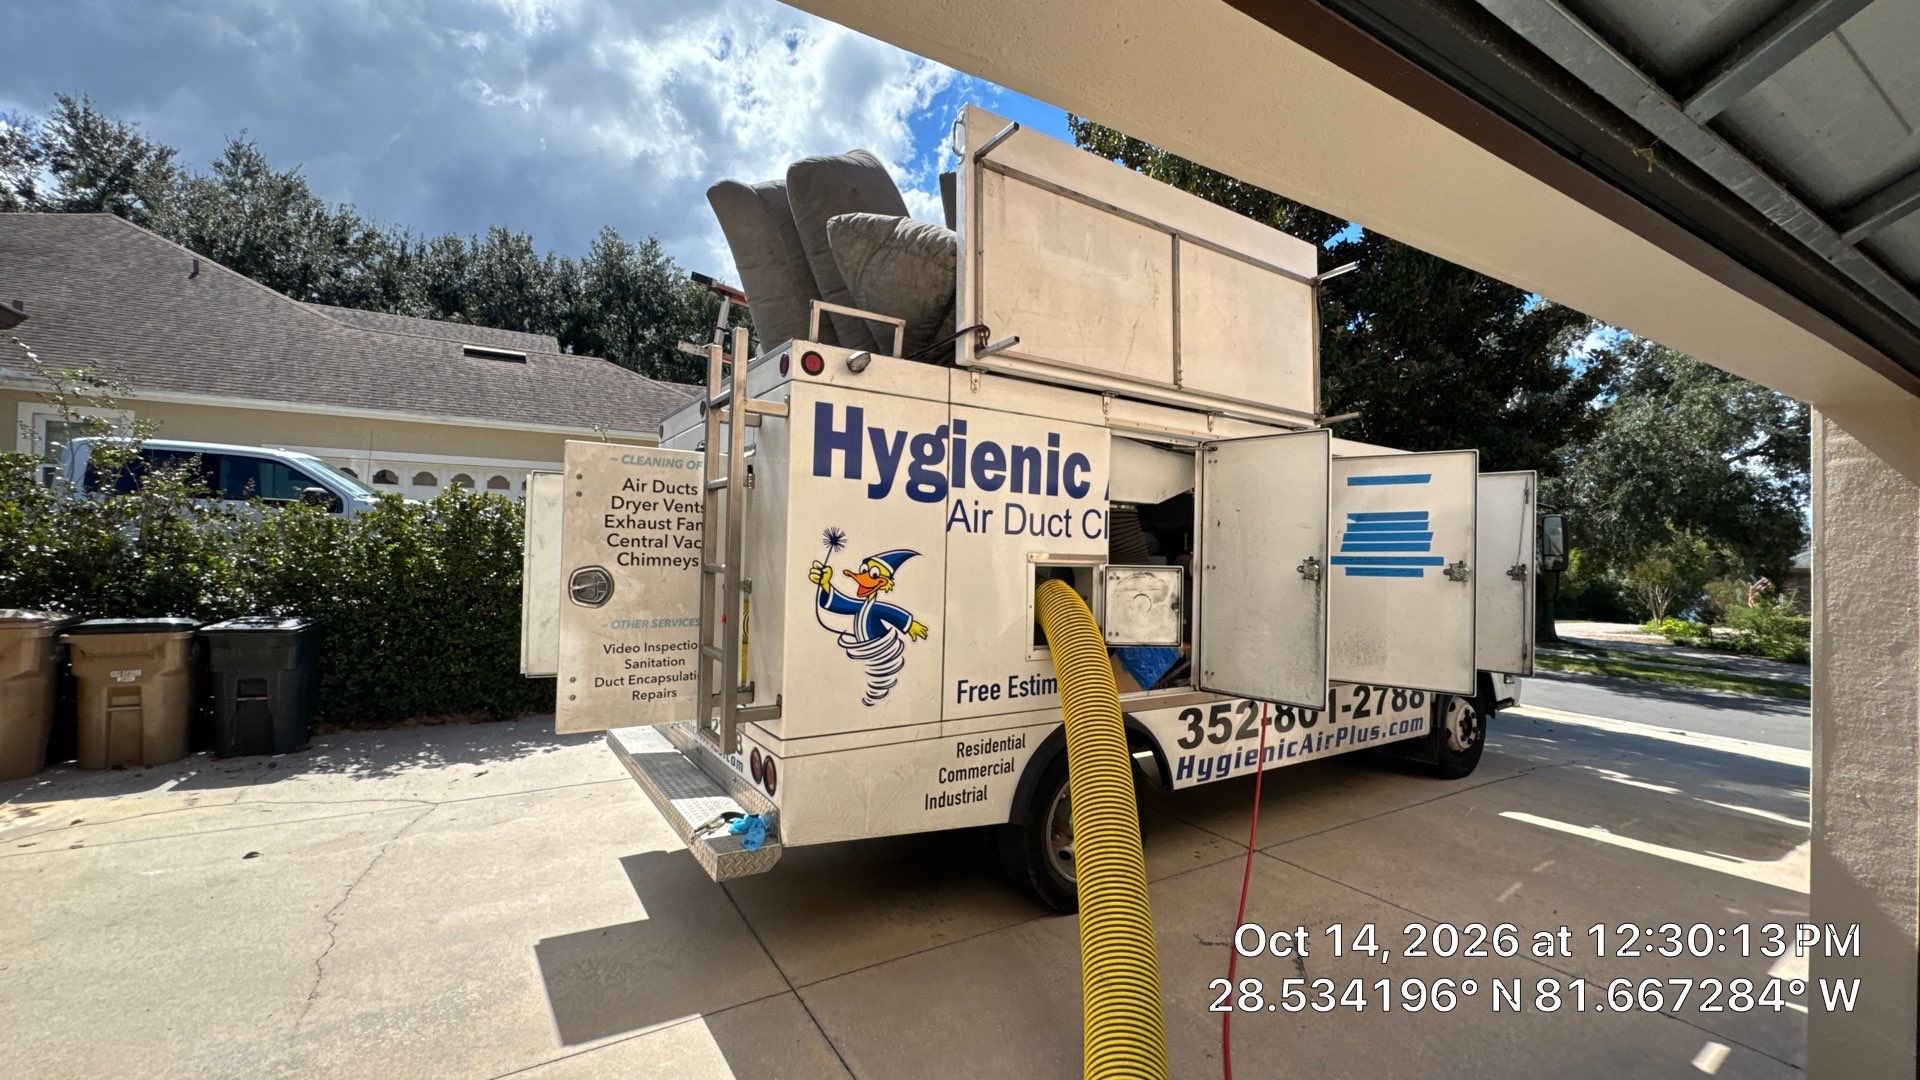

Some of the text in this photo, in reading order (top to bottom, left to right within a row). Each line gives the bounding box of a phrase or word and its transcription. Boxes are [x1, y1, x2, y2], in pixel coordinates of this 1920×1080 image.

[812, 400, 1092, 504] Hygienic
[621, 454, 684, 470] CLEANING
[686, 460, 703, 471] OF
[622, 477, 699, 496] Air Ducts
[611, 495, 660, 515] Dryer
[604, 514, 673, 531] Exhaust
[946, 498, 994, 535] Air
[1003, 502, 1073, 540] Duct
[606, 532, 669, 549] Central
[616, 551, 700, 571] Chimneys
[611, 619, 649, 630] OTHER
[651, 617, 703, 629] SERVICES
[602, 640, 699, 655] Video Inspectio
[624, 656, 686, 670] Sanitation
[594, 670, 700, 688] Duct Encapsulati
[631, 687, 678, 703] Repairs
[956, 673, 1059, 705] Free Estim
[956, 732, 1027, 759] Residential
[1175, 716, 1424, 783] HygienicAirPlus.com
[937, 756, 1016, 785] Commercial
[924, 784, 988, 811] Industrial
